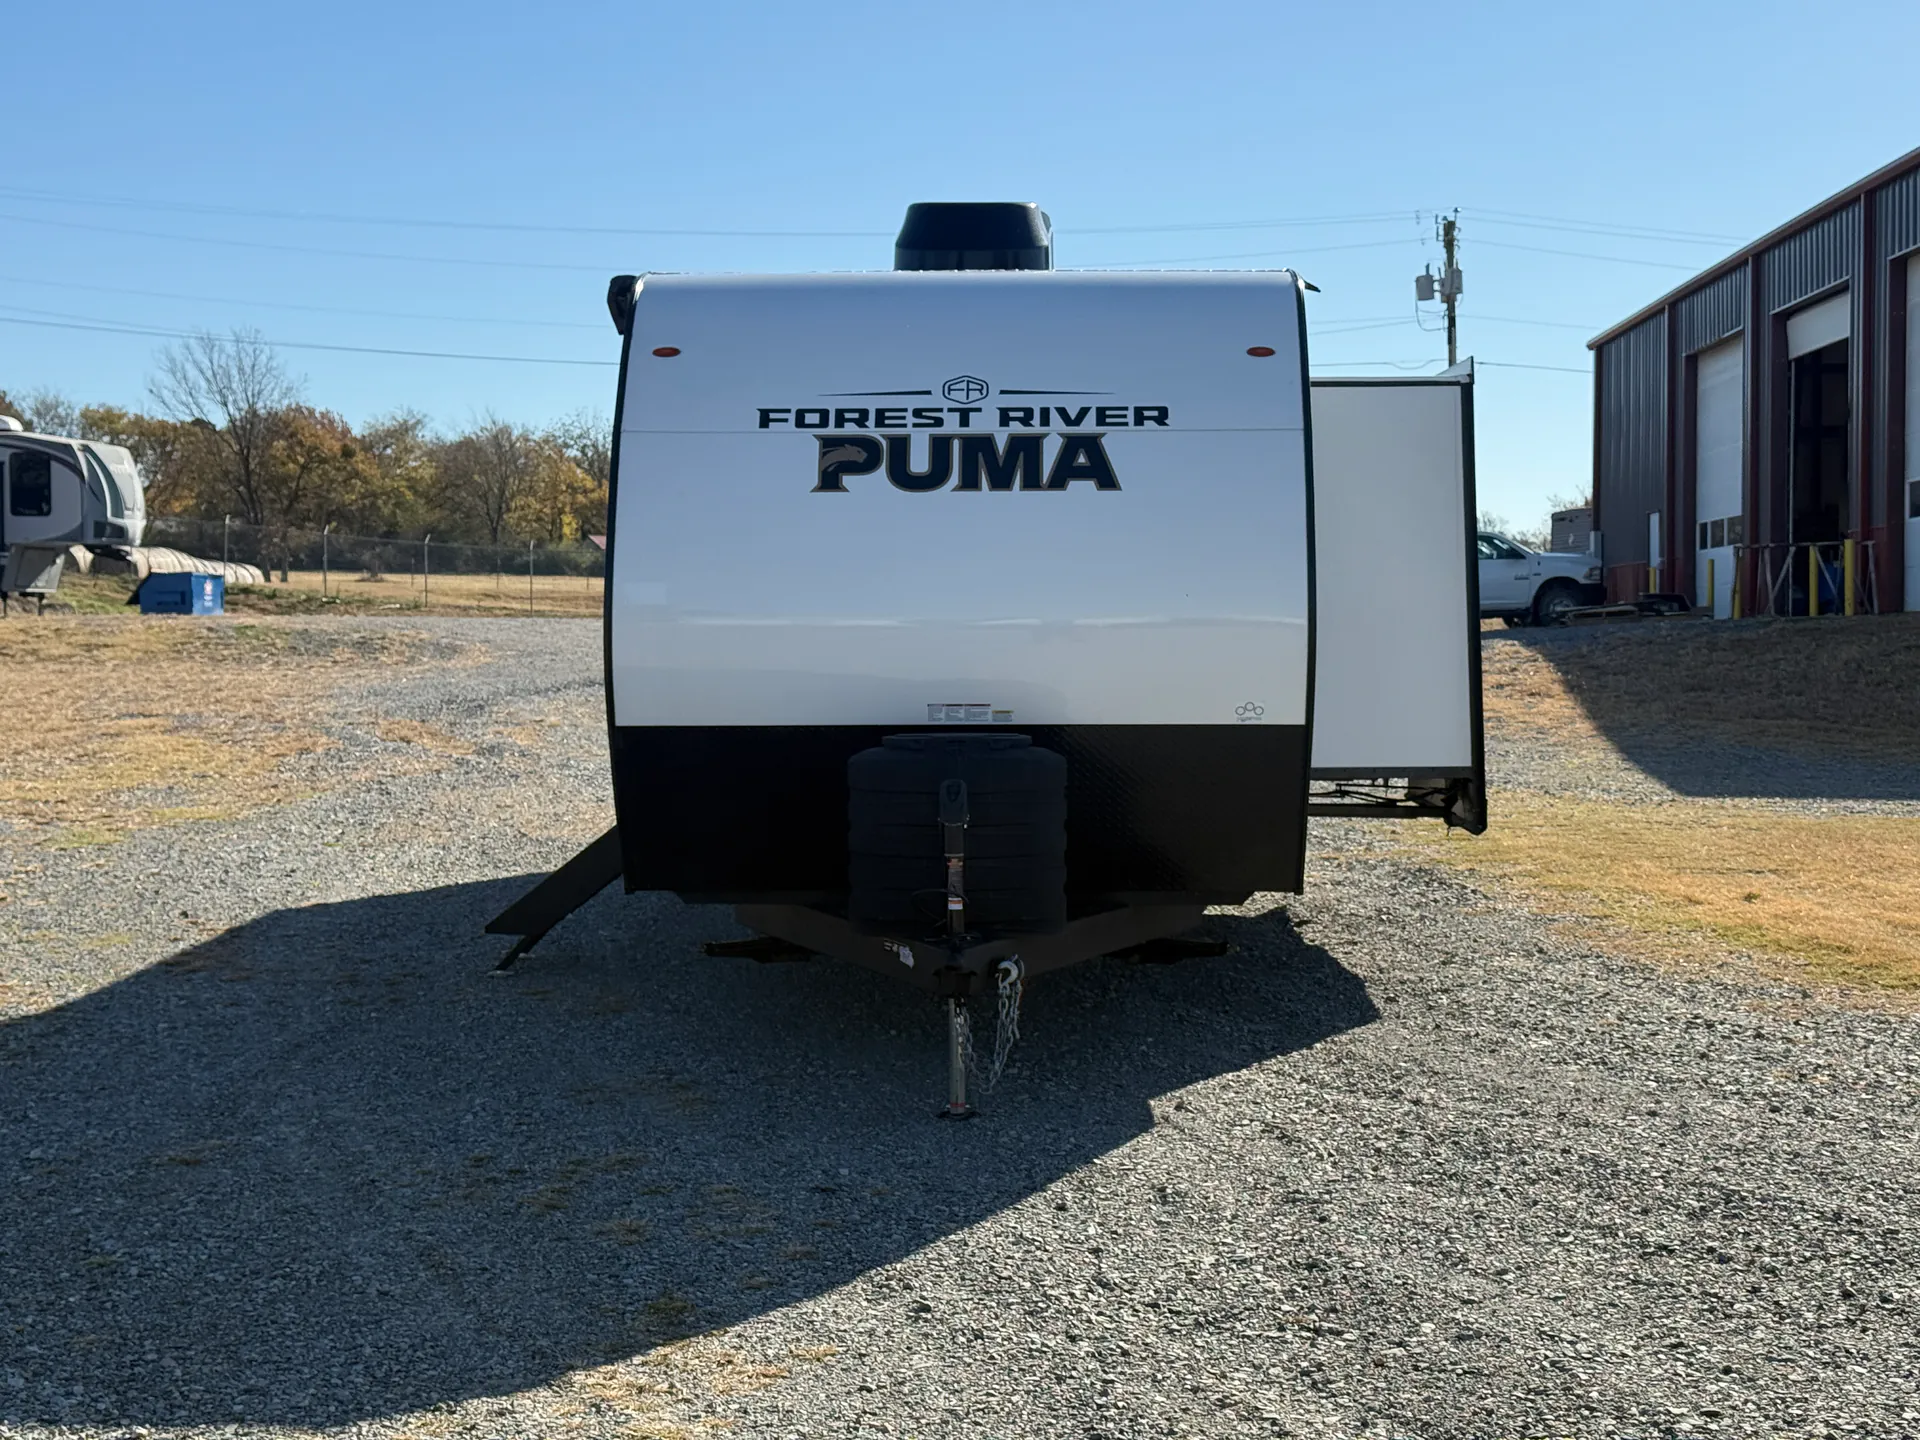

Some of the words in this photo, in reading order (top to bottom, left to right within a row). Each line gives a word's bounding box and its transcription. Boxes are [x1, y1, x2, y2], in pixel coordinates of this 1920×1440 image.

[948, 379, 984, 401] FR
[756, 407, 983, 429] FOREST
[996, 406, 1171, 428] RIVER
[809, 433, 1123, 493] PUMA
